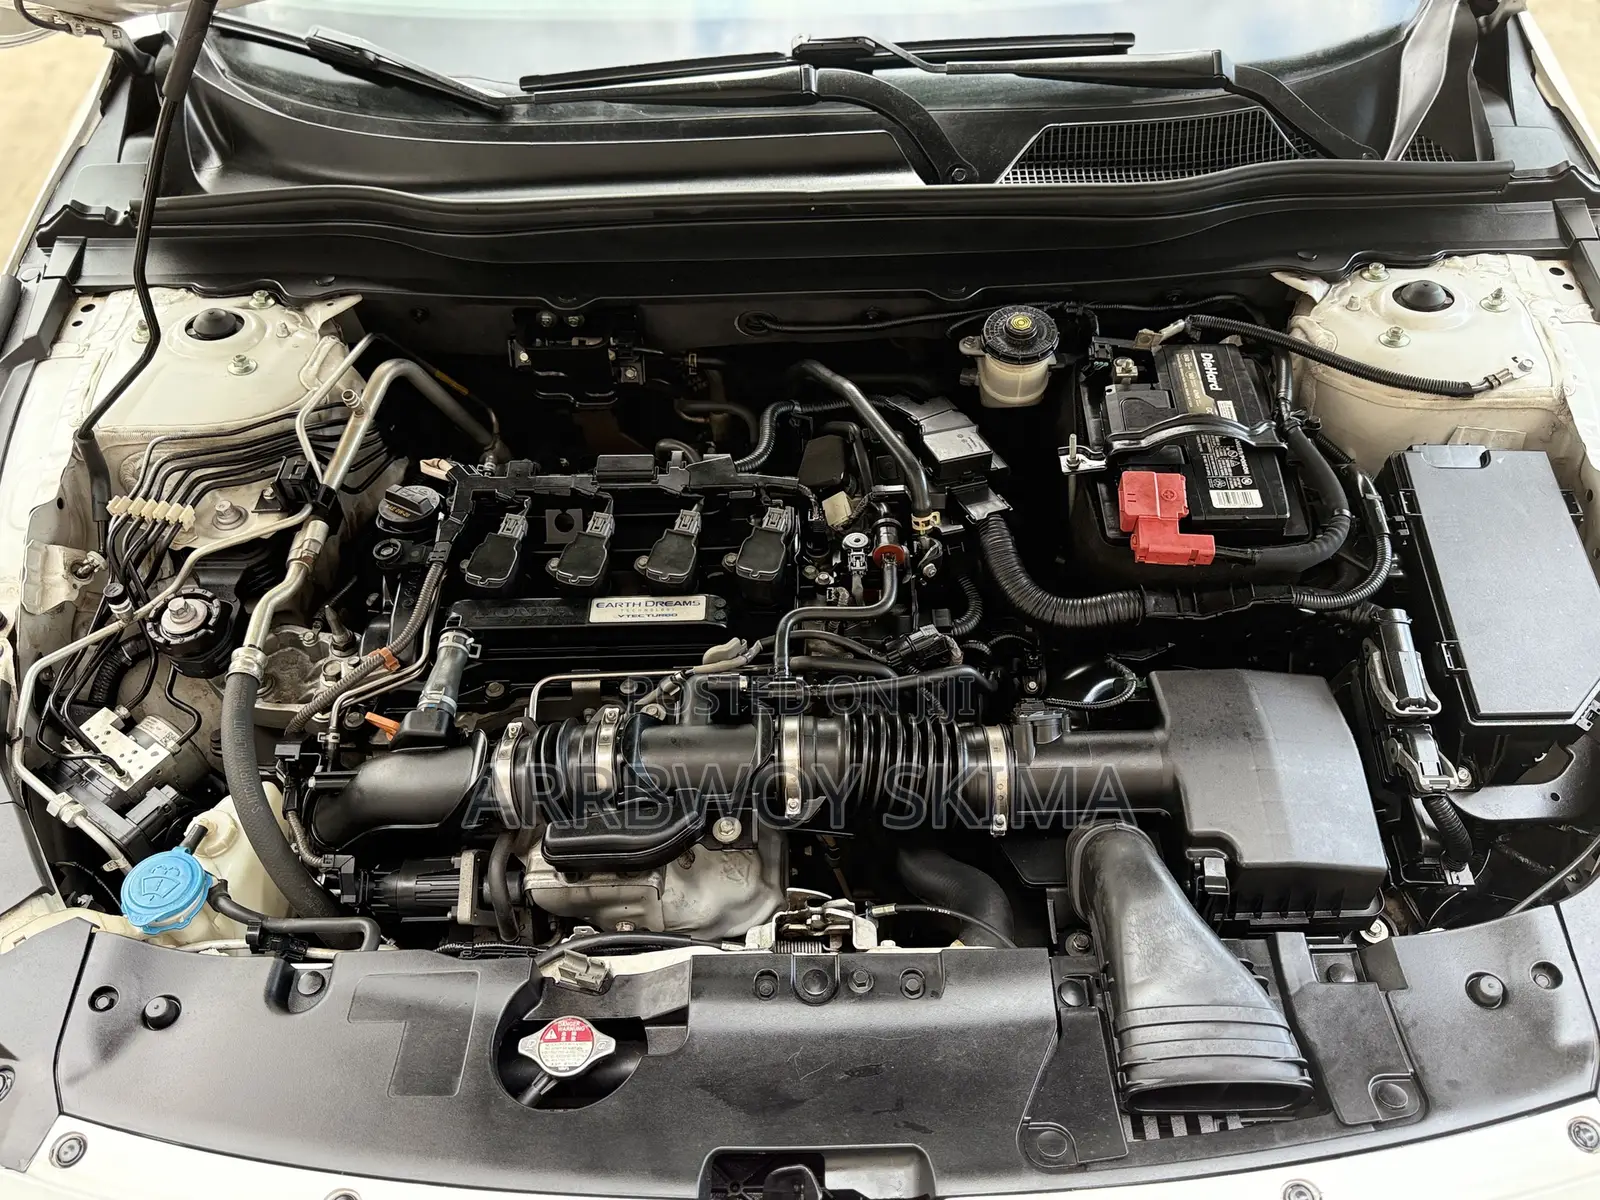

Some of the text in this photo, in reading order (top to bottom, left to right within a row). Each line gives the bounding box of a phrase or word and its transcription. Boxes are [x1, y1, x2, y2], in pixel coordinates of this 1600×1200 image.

[1200, 352, 1223, 392] DieHard
[596, 600, 701, 609] EARTH DREAMS
